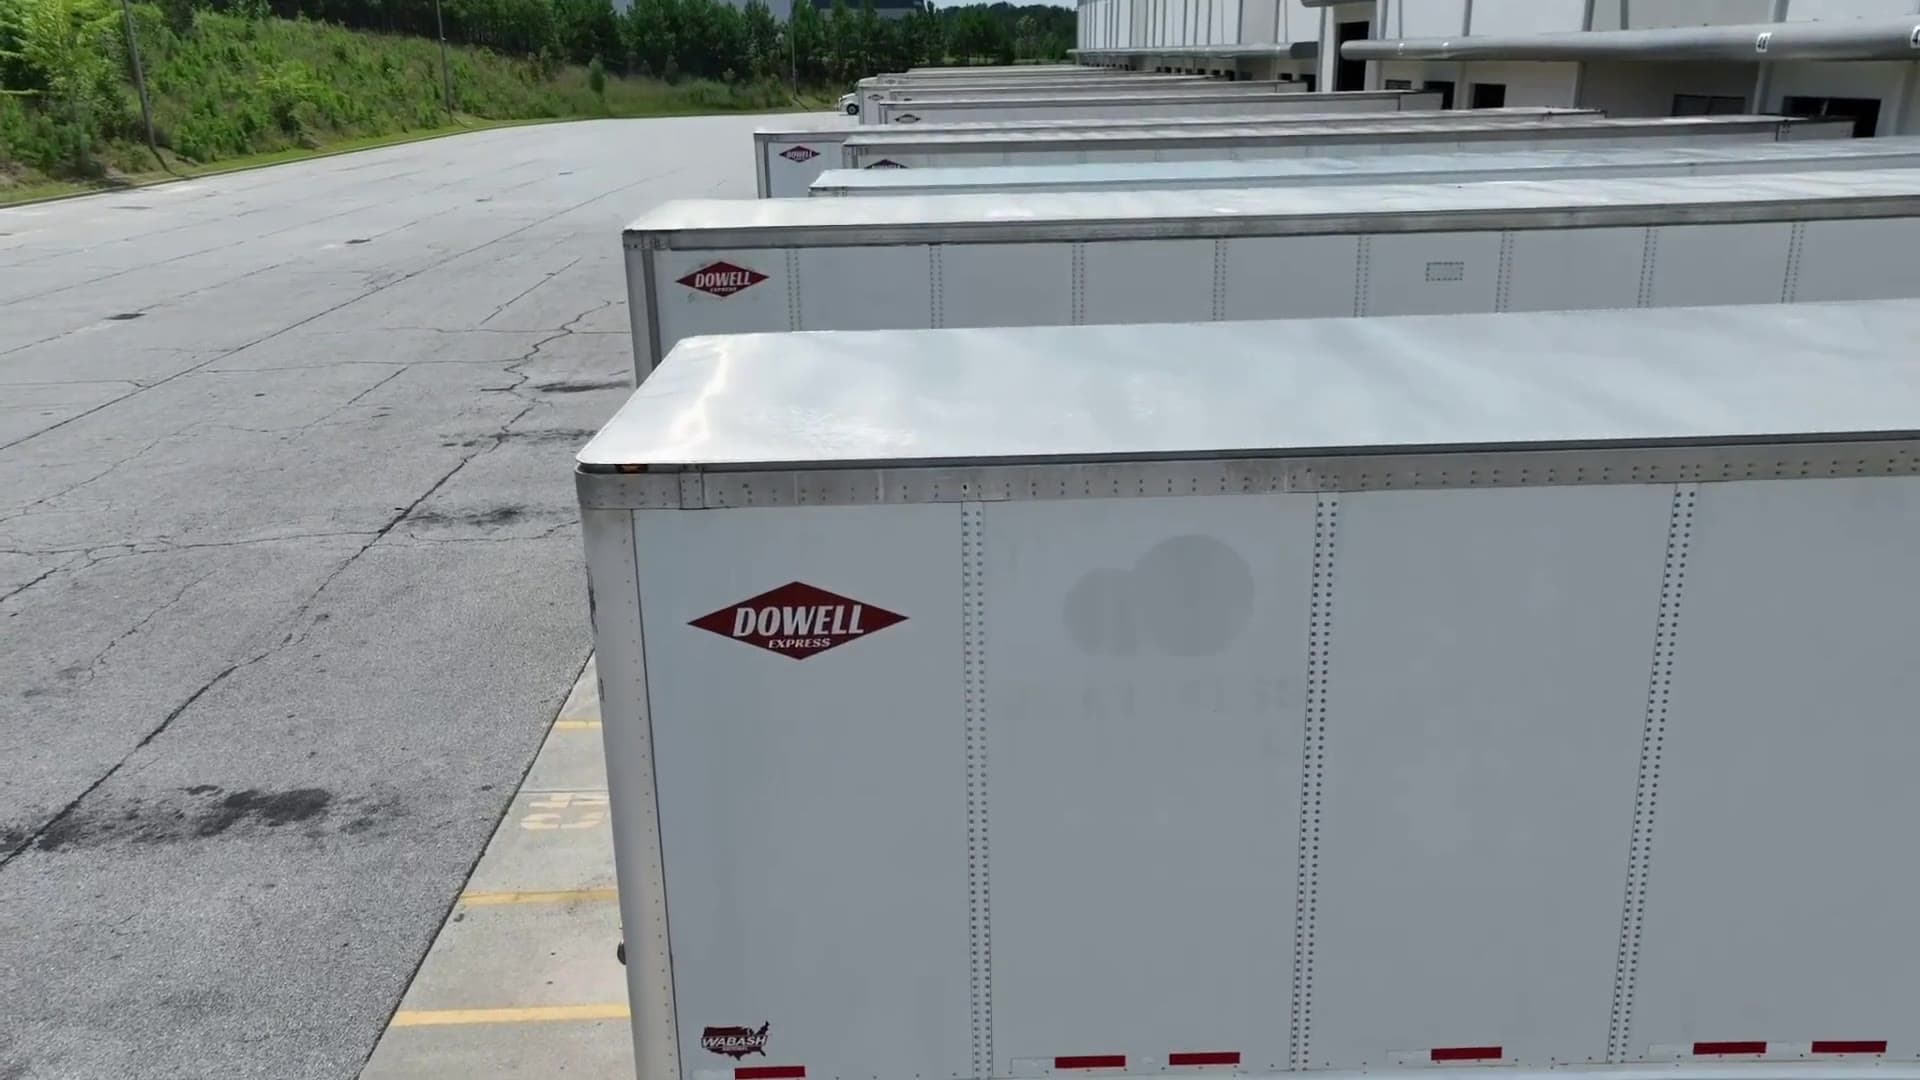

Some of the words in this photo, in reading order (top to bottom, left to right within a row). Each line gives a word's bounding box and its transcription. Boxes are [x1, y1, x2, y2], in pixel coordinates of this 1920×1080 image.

[695, 272, 751, 287] DOWELL
[732, 604, 864, 637] DOWELL
[768, 637, 831, 648] EXPRESS
[702, 1036, 767, 1047] WABASH
